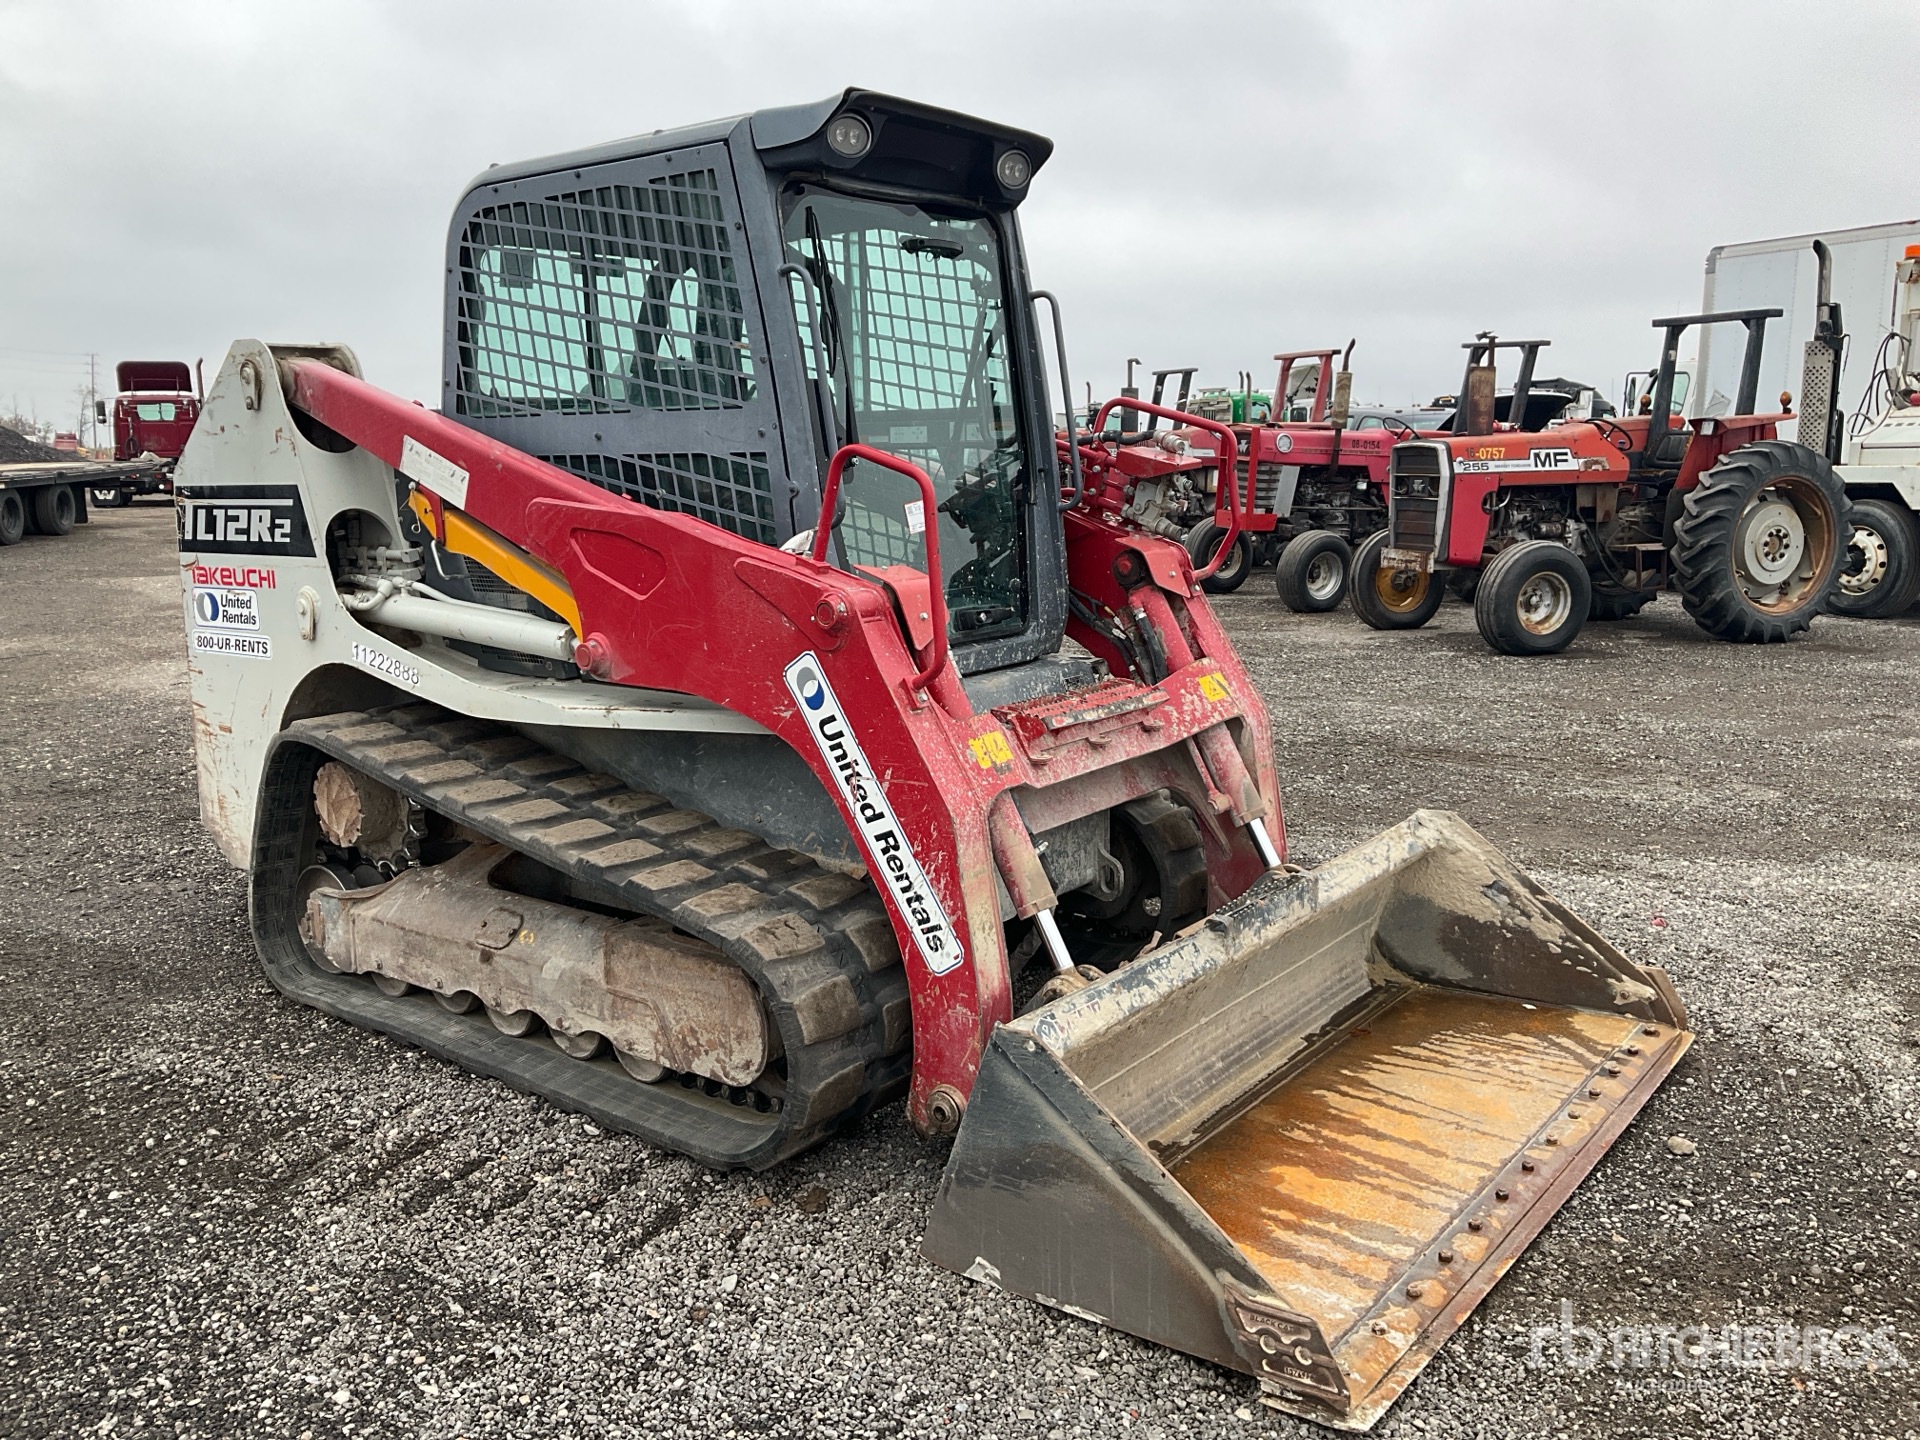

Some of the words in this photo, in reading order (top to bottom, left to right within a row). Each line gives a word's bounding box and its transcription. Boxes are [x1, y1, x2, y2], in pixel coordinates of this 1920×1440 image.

[1351, 439, 1380, 449] 08-0154
[1463, 462, 1489, 471] 255
[1533, 451, 1568, 468] MF
[220, 594, 252, 609] United
[222, 610, 257, 625] Rentals
[197, 636, 268, 655] 800-UR-RENTS
[353, 644, 420, 685] 11222888
[818, 714, 885, 824] United
[874, 830, 945, 954] Rentals
[1249, 1314, 1276, 1327] BLACK
